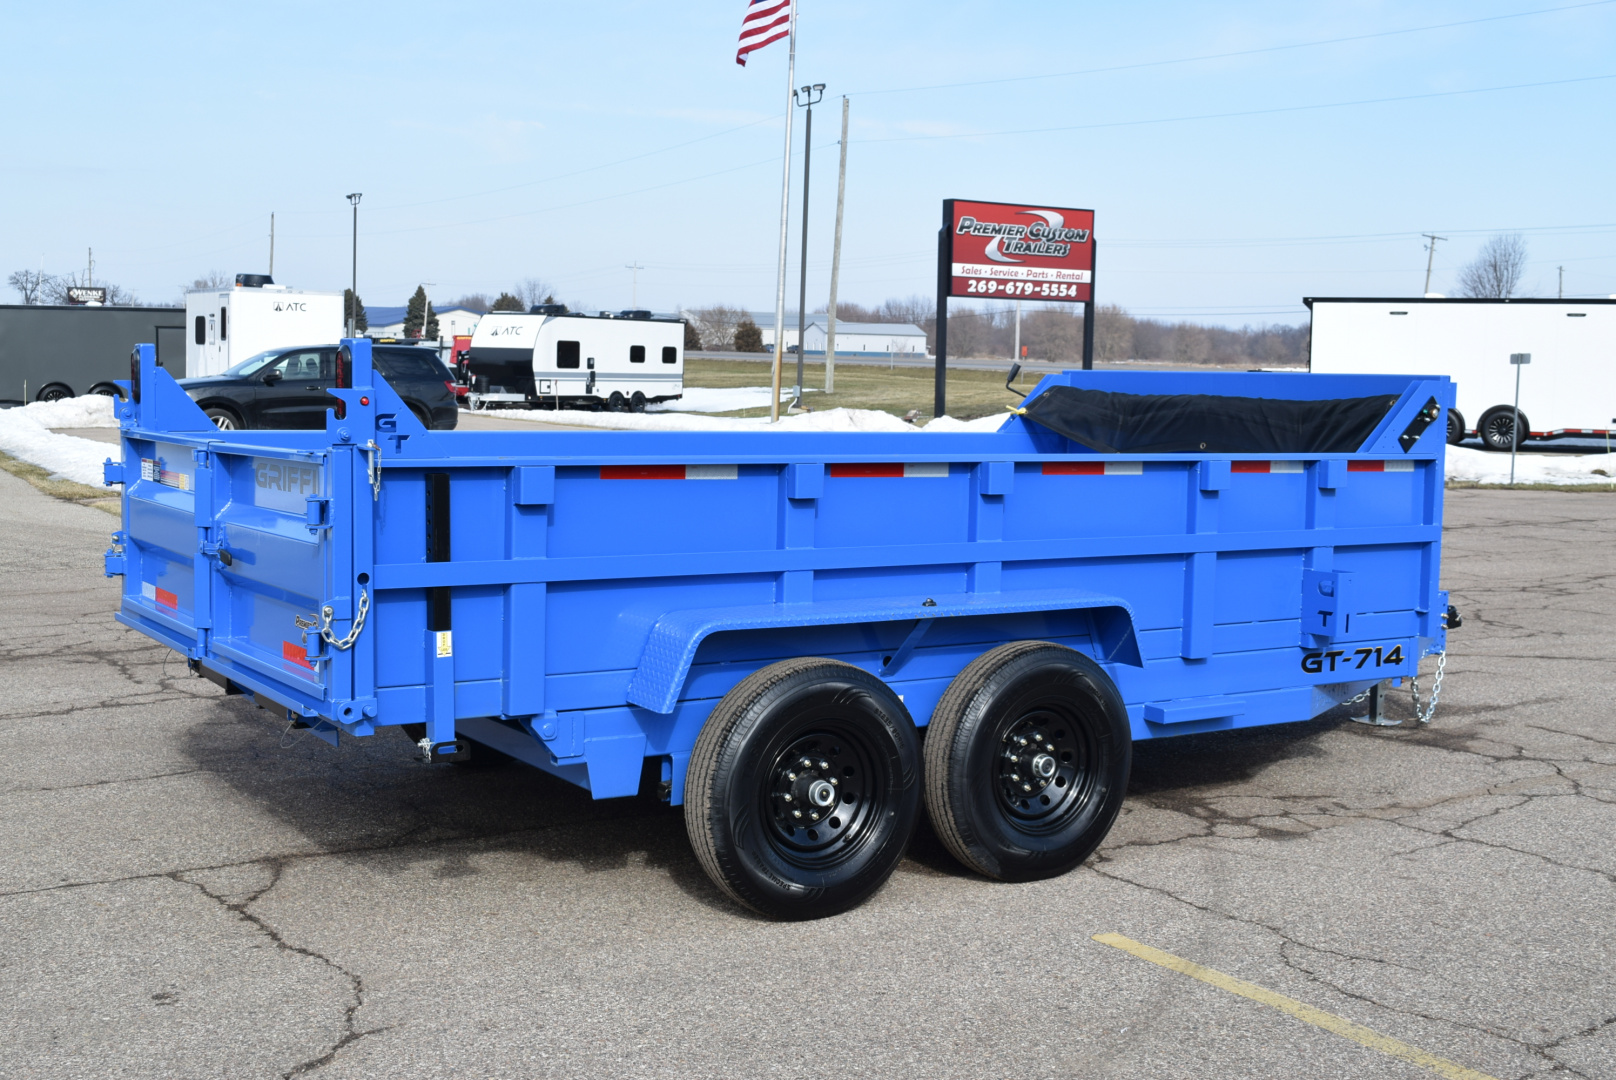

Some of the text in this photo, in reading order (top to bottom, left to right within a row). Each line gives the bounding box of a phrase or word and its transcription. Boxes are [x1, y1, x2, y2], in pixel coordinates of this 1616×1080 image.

[956, 216, 1090, 243] PREMIER CUSTOM
[1003, 237, 1071, 257] TRAILERS
[961, 266, 1083, 281] Sales Service Parts Rental
[967, 279, 1077, 298] 269-679-5554
[286, 302, 307, 312] ATC
[501, 326, 523, 336] ATC
[1301, 644, 1405, 674] GT-714
